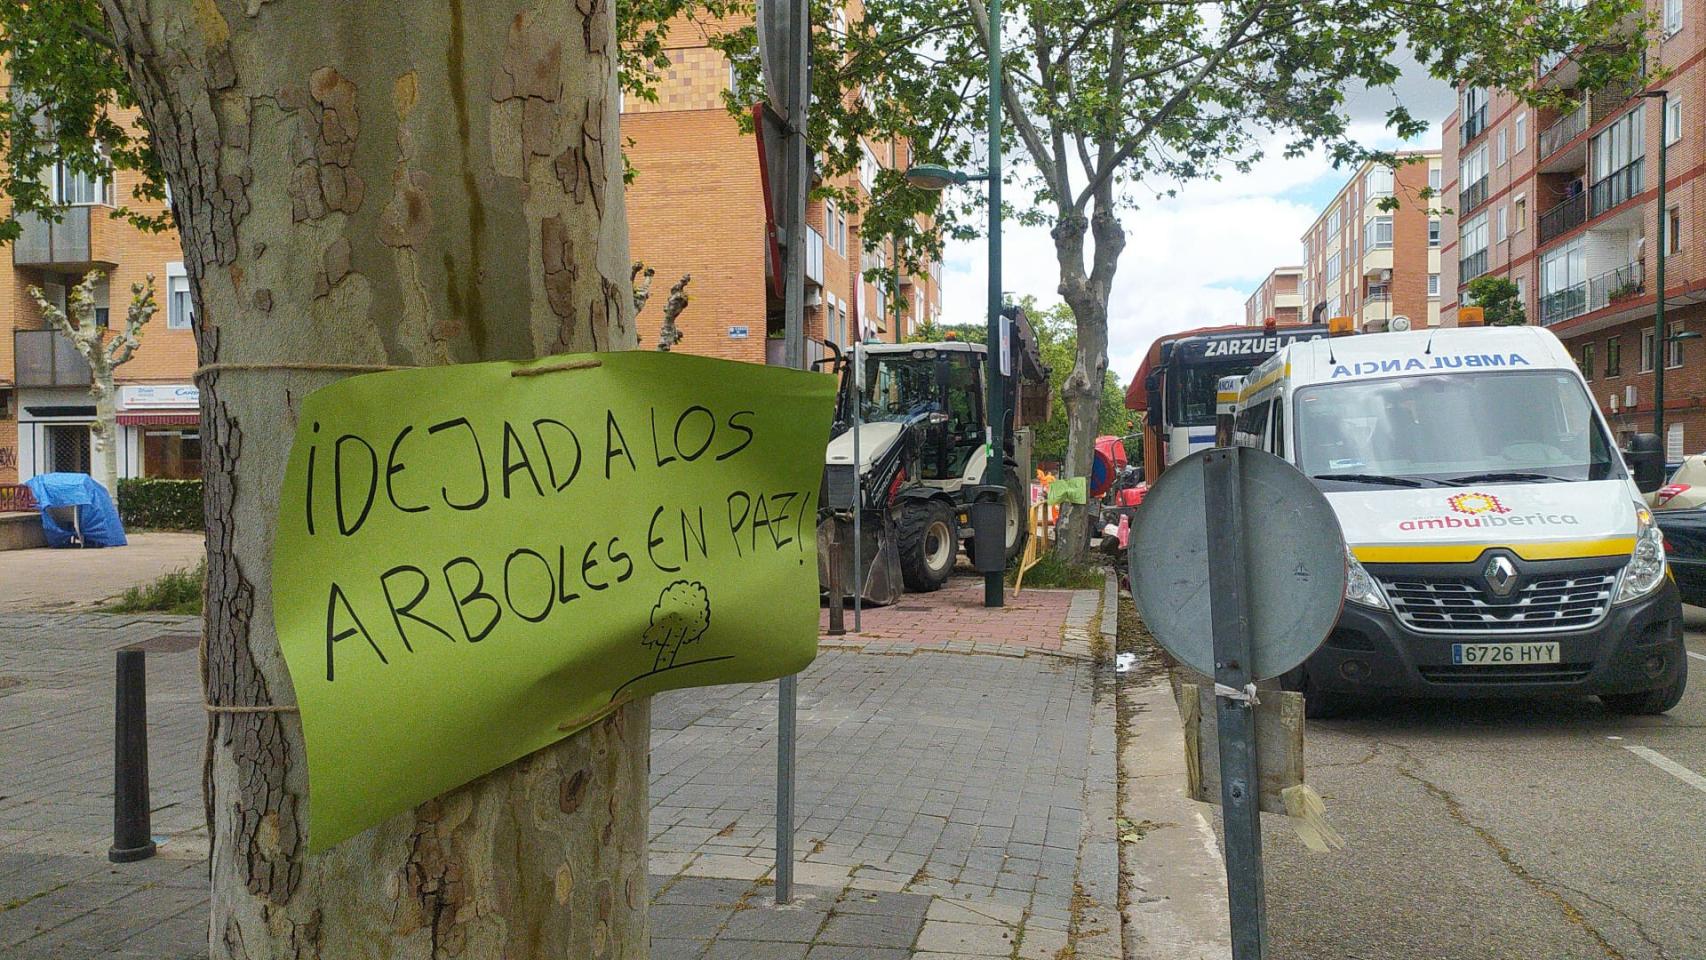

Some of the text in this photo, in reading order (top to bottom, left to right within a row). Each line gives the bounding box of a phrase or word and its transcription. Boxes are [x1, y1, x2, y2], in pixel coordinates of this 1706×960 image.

[306, 405, 756, 537] ¡DEJAD A LOS
[326, 490, 811, 682] ARBOLES EN PAZ!
[1466, 644, 1555, 662] 6726 HYY
